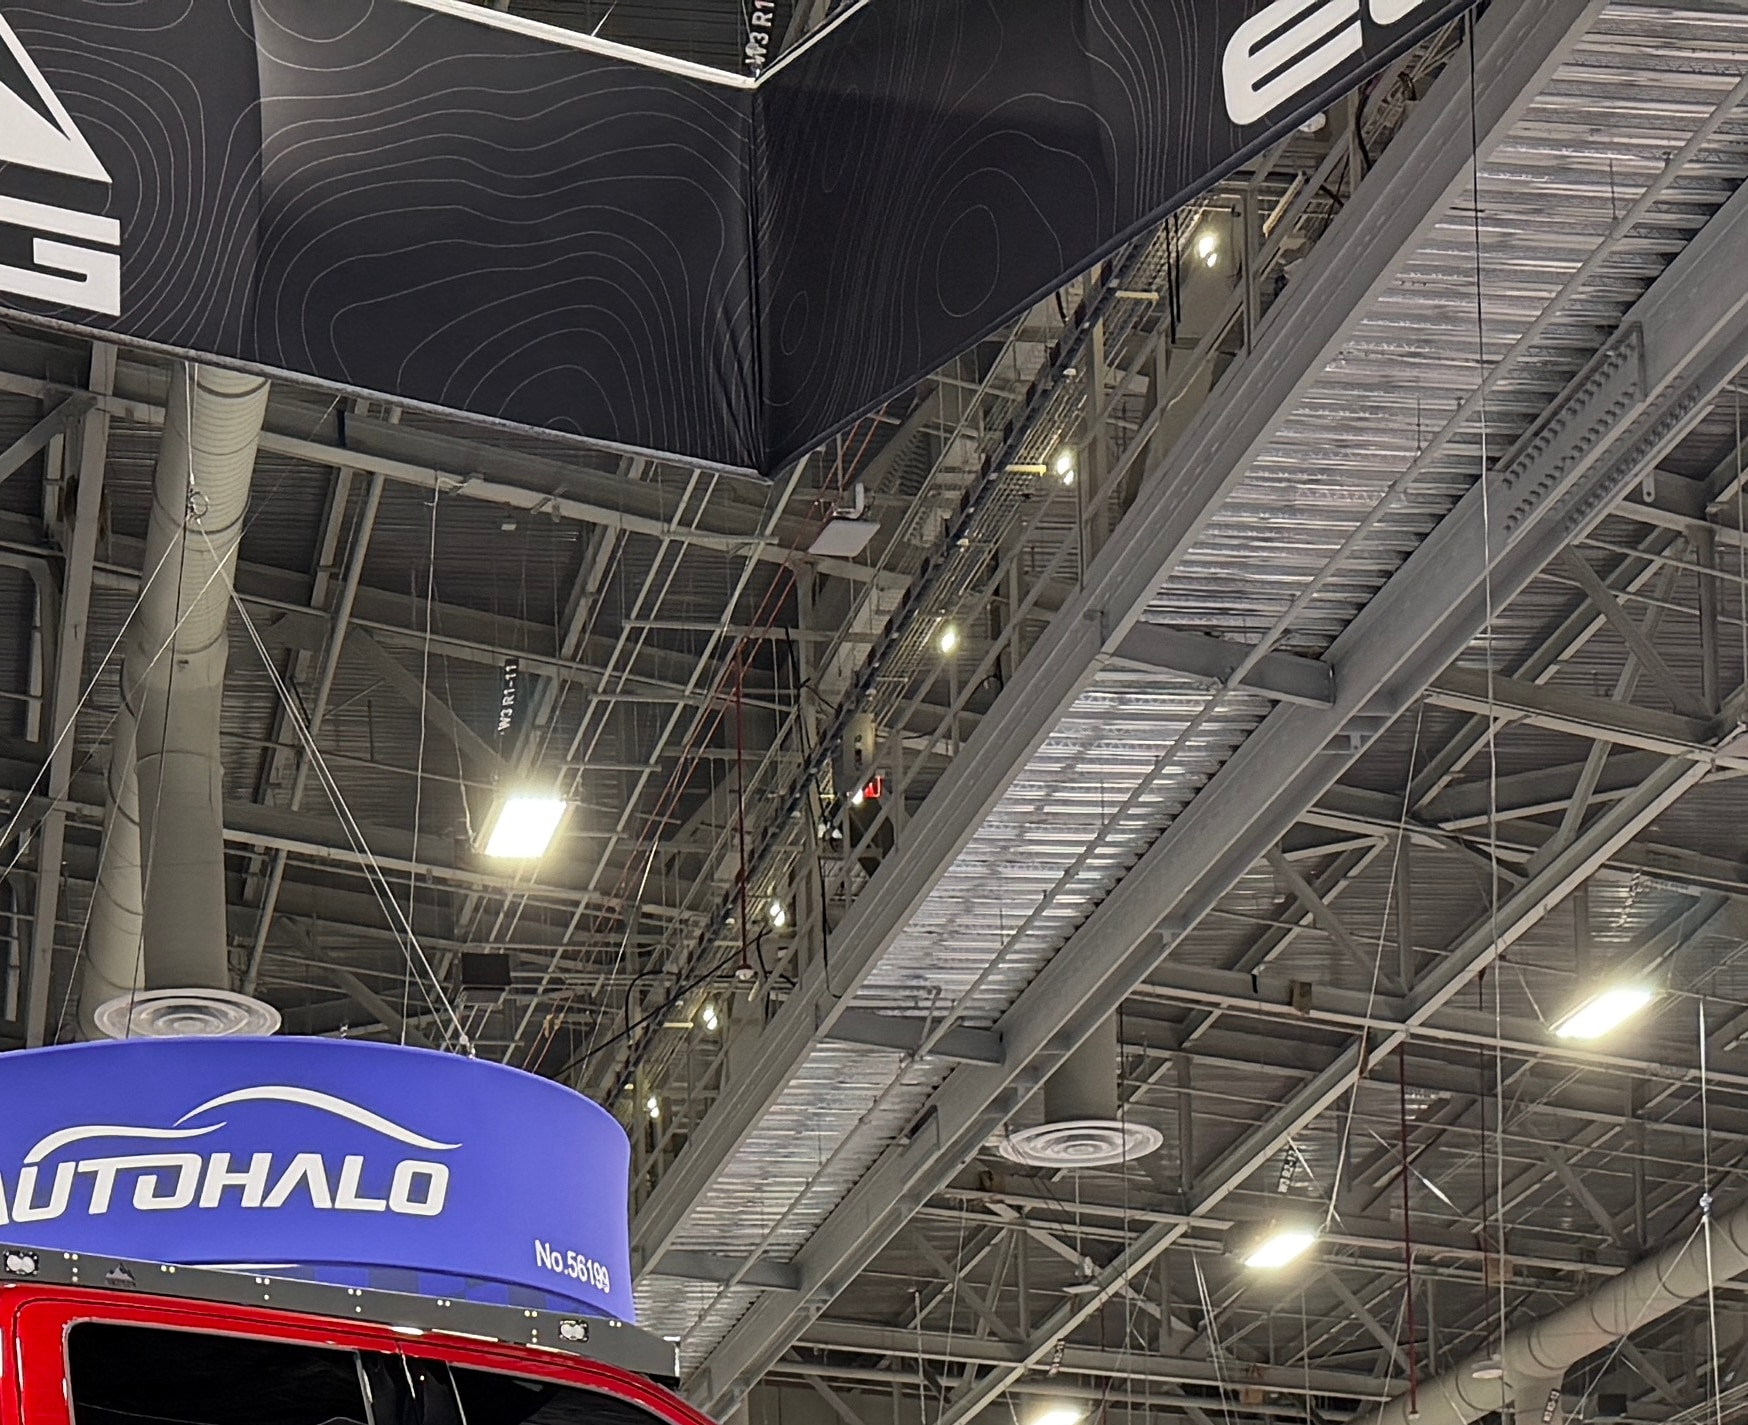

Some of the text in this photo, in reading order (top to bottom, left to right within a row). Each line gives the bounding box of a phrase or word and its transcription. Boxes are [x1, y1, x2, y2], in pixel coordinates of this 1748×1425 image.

[497, 664, 516, 732] W3 R1-11
[534, 1239, 610, 1294] No.56199
